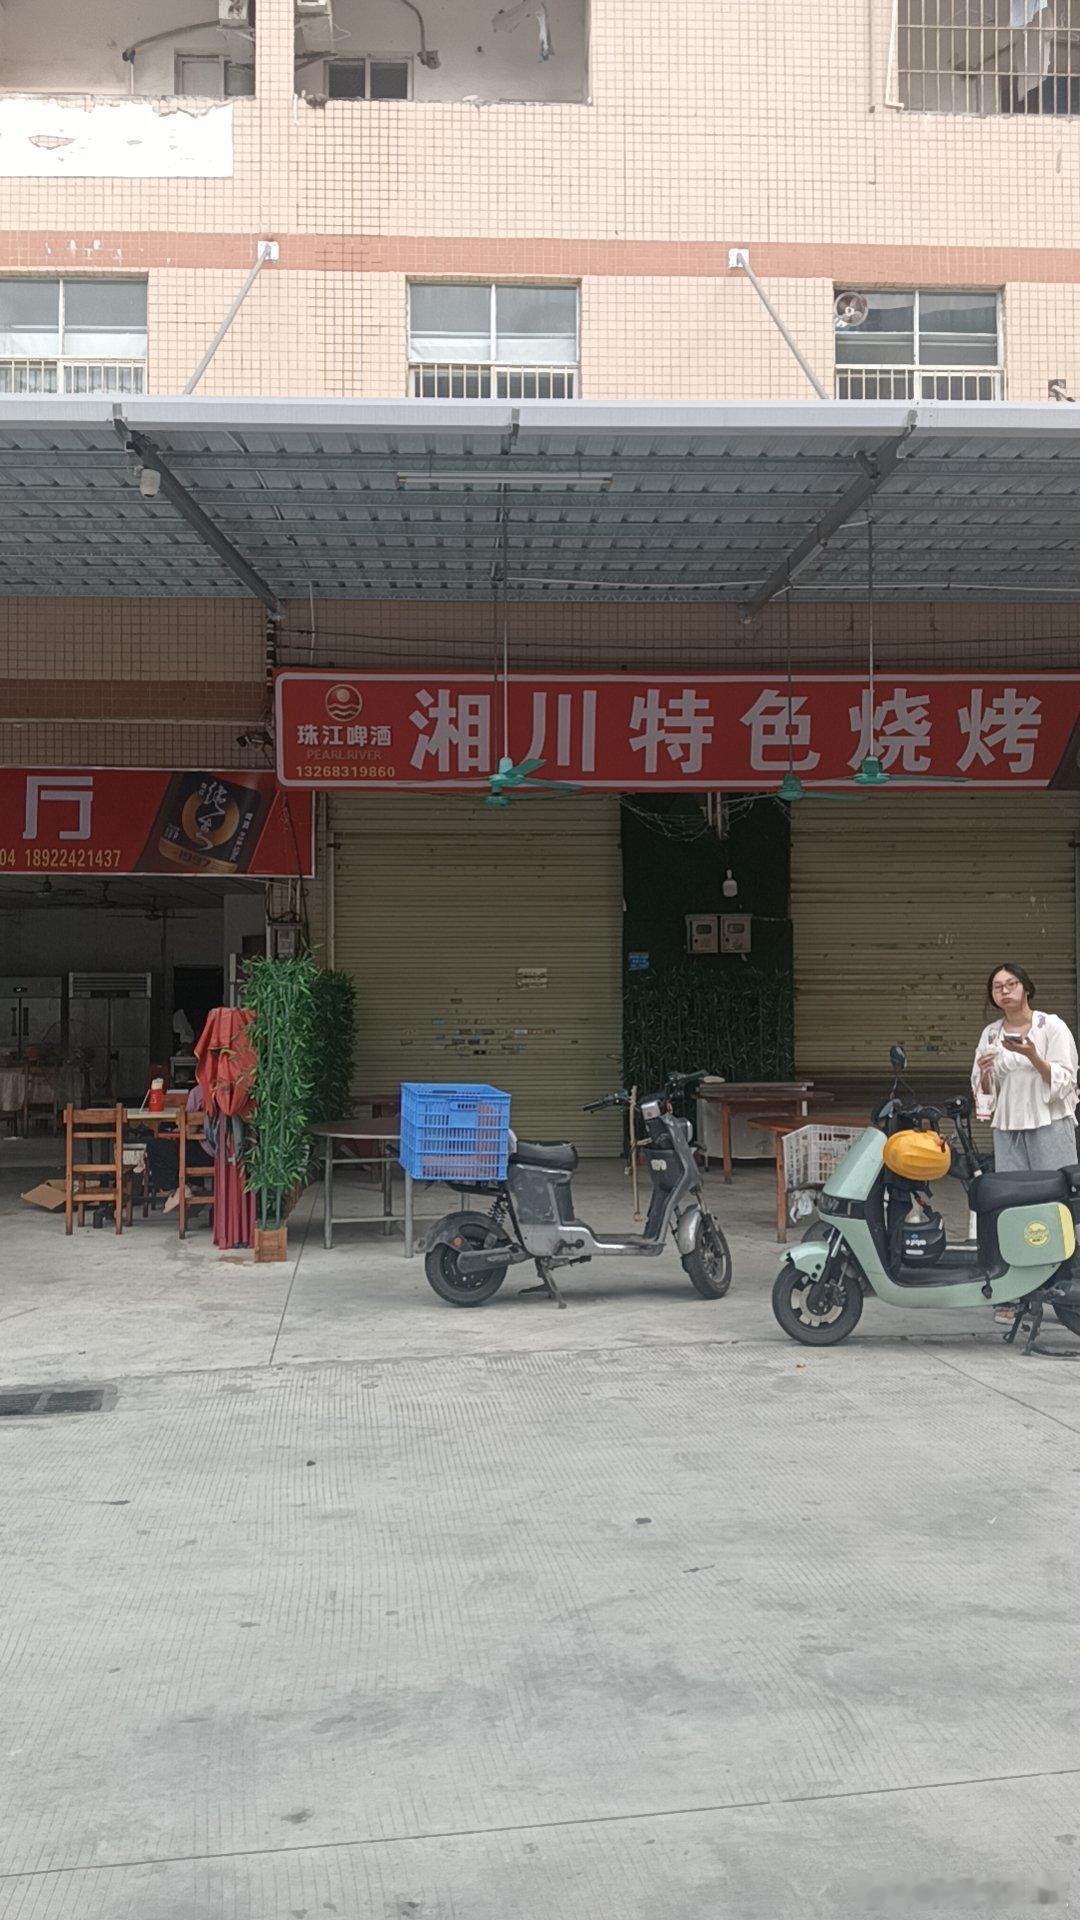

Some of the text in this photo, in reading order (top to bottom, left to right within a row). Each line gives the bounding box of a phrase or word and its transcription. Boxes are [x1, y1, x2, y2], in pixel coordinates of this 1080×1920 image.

[297, 724, 391, 746] 珠江啤酒
[409, 688, 1042, 773] 湘川特色烧烤
[307, 749, 381, 760] PEARL RIVER
[296, 766, 395, 777] 13268319860
[25, 848, 121, 867] 18922421437
